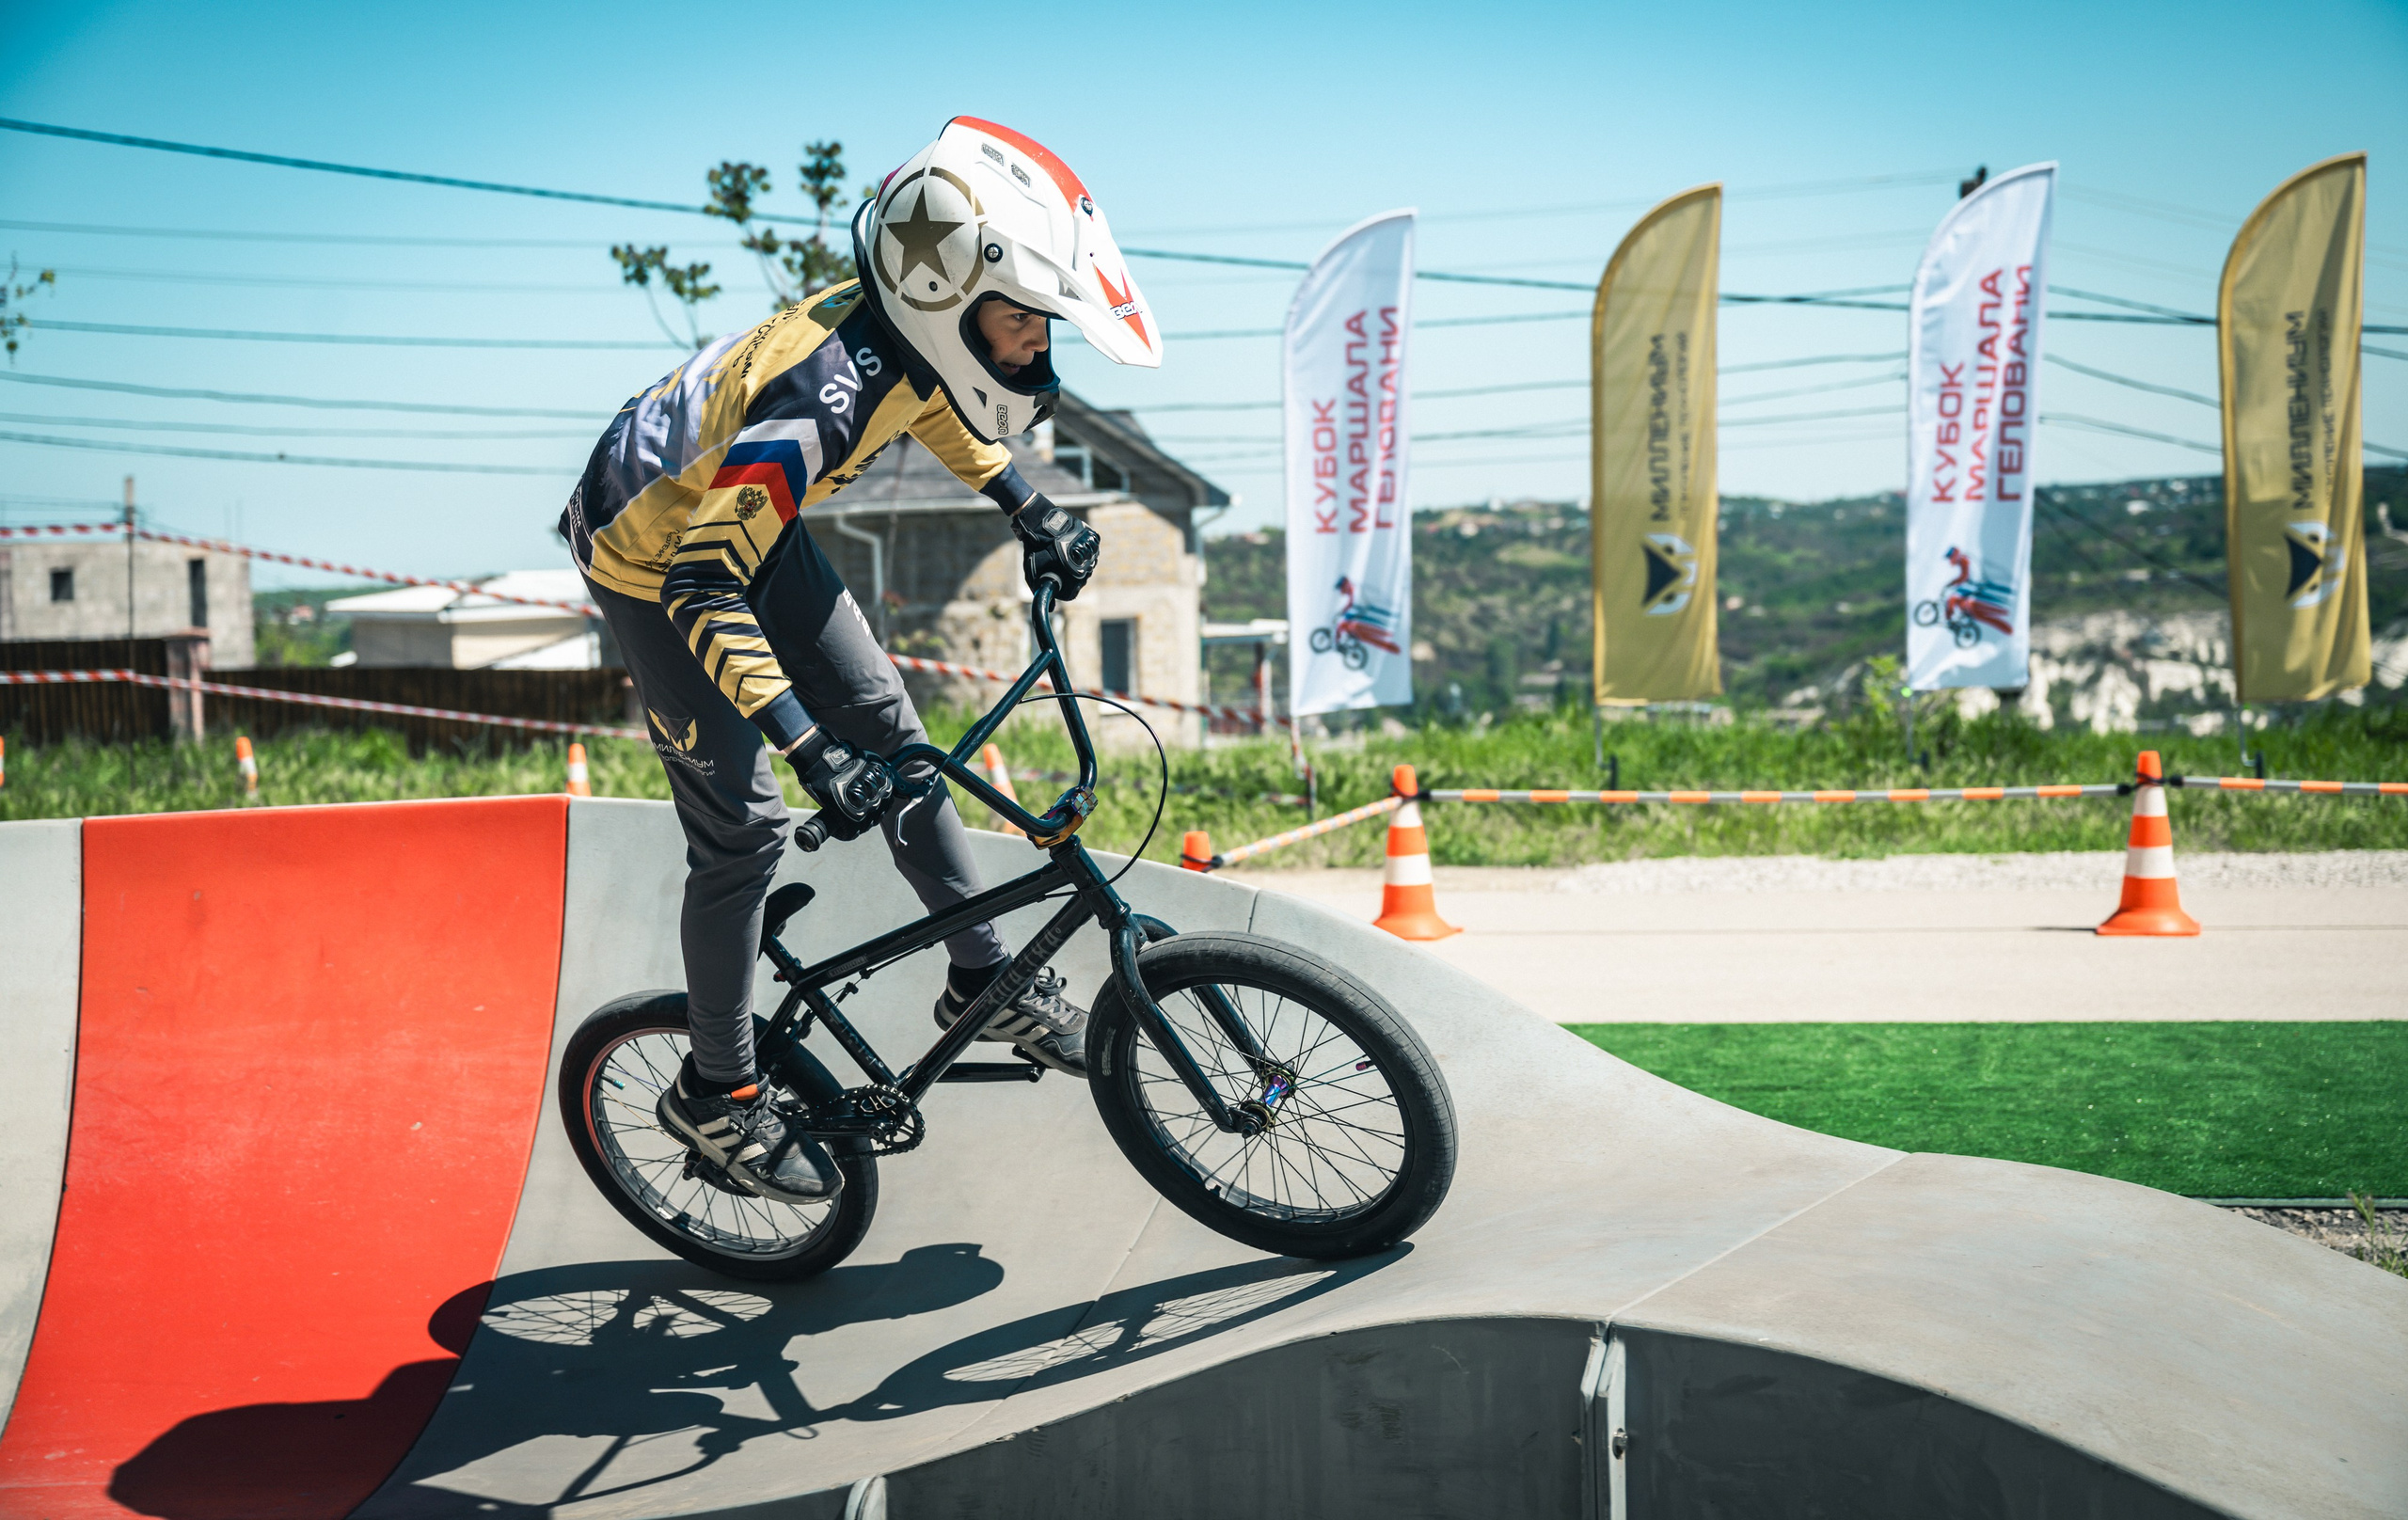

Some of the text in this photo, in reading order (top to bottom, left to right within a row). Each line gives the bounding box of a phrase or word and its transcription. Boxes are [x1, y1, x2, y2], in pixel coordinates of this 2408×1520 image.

[819, 347, 882, 414] SVS
[1312, 398, 1338, 533] КУБОК
[1345, 309, 1370, 533] МАРШАЛА
[1931, 361, 1964, 502] КУБОК
[1964, 268, 2004, 500] МАРШАЛА
[1997, 265, 2032, 501] ГЕЛОВАНИ
